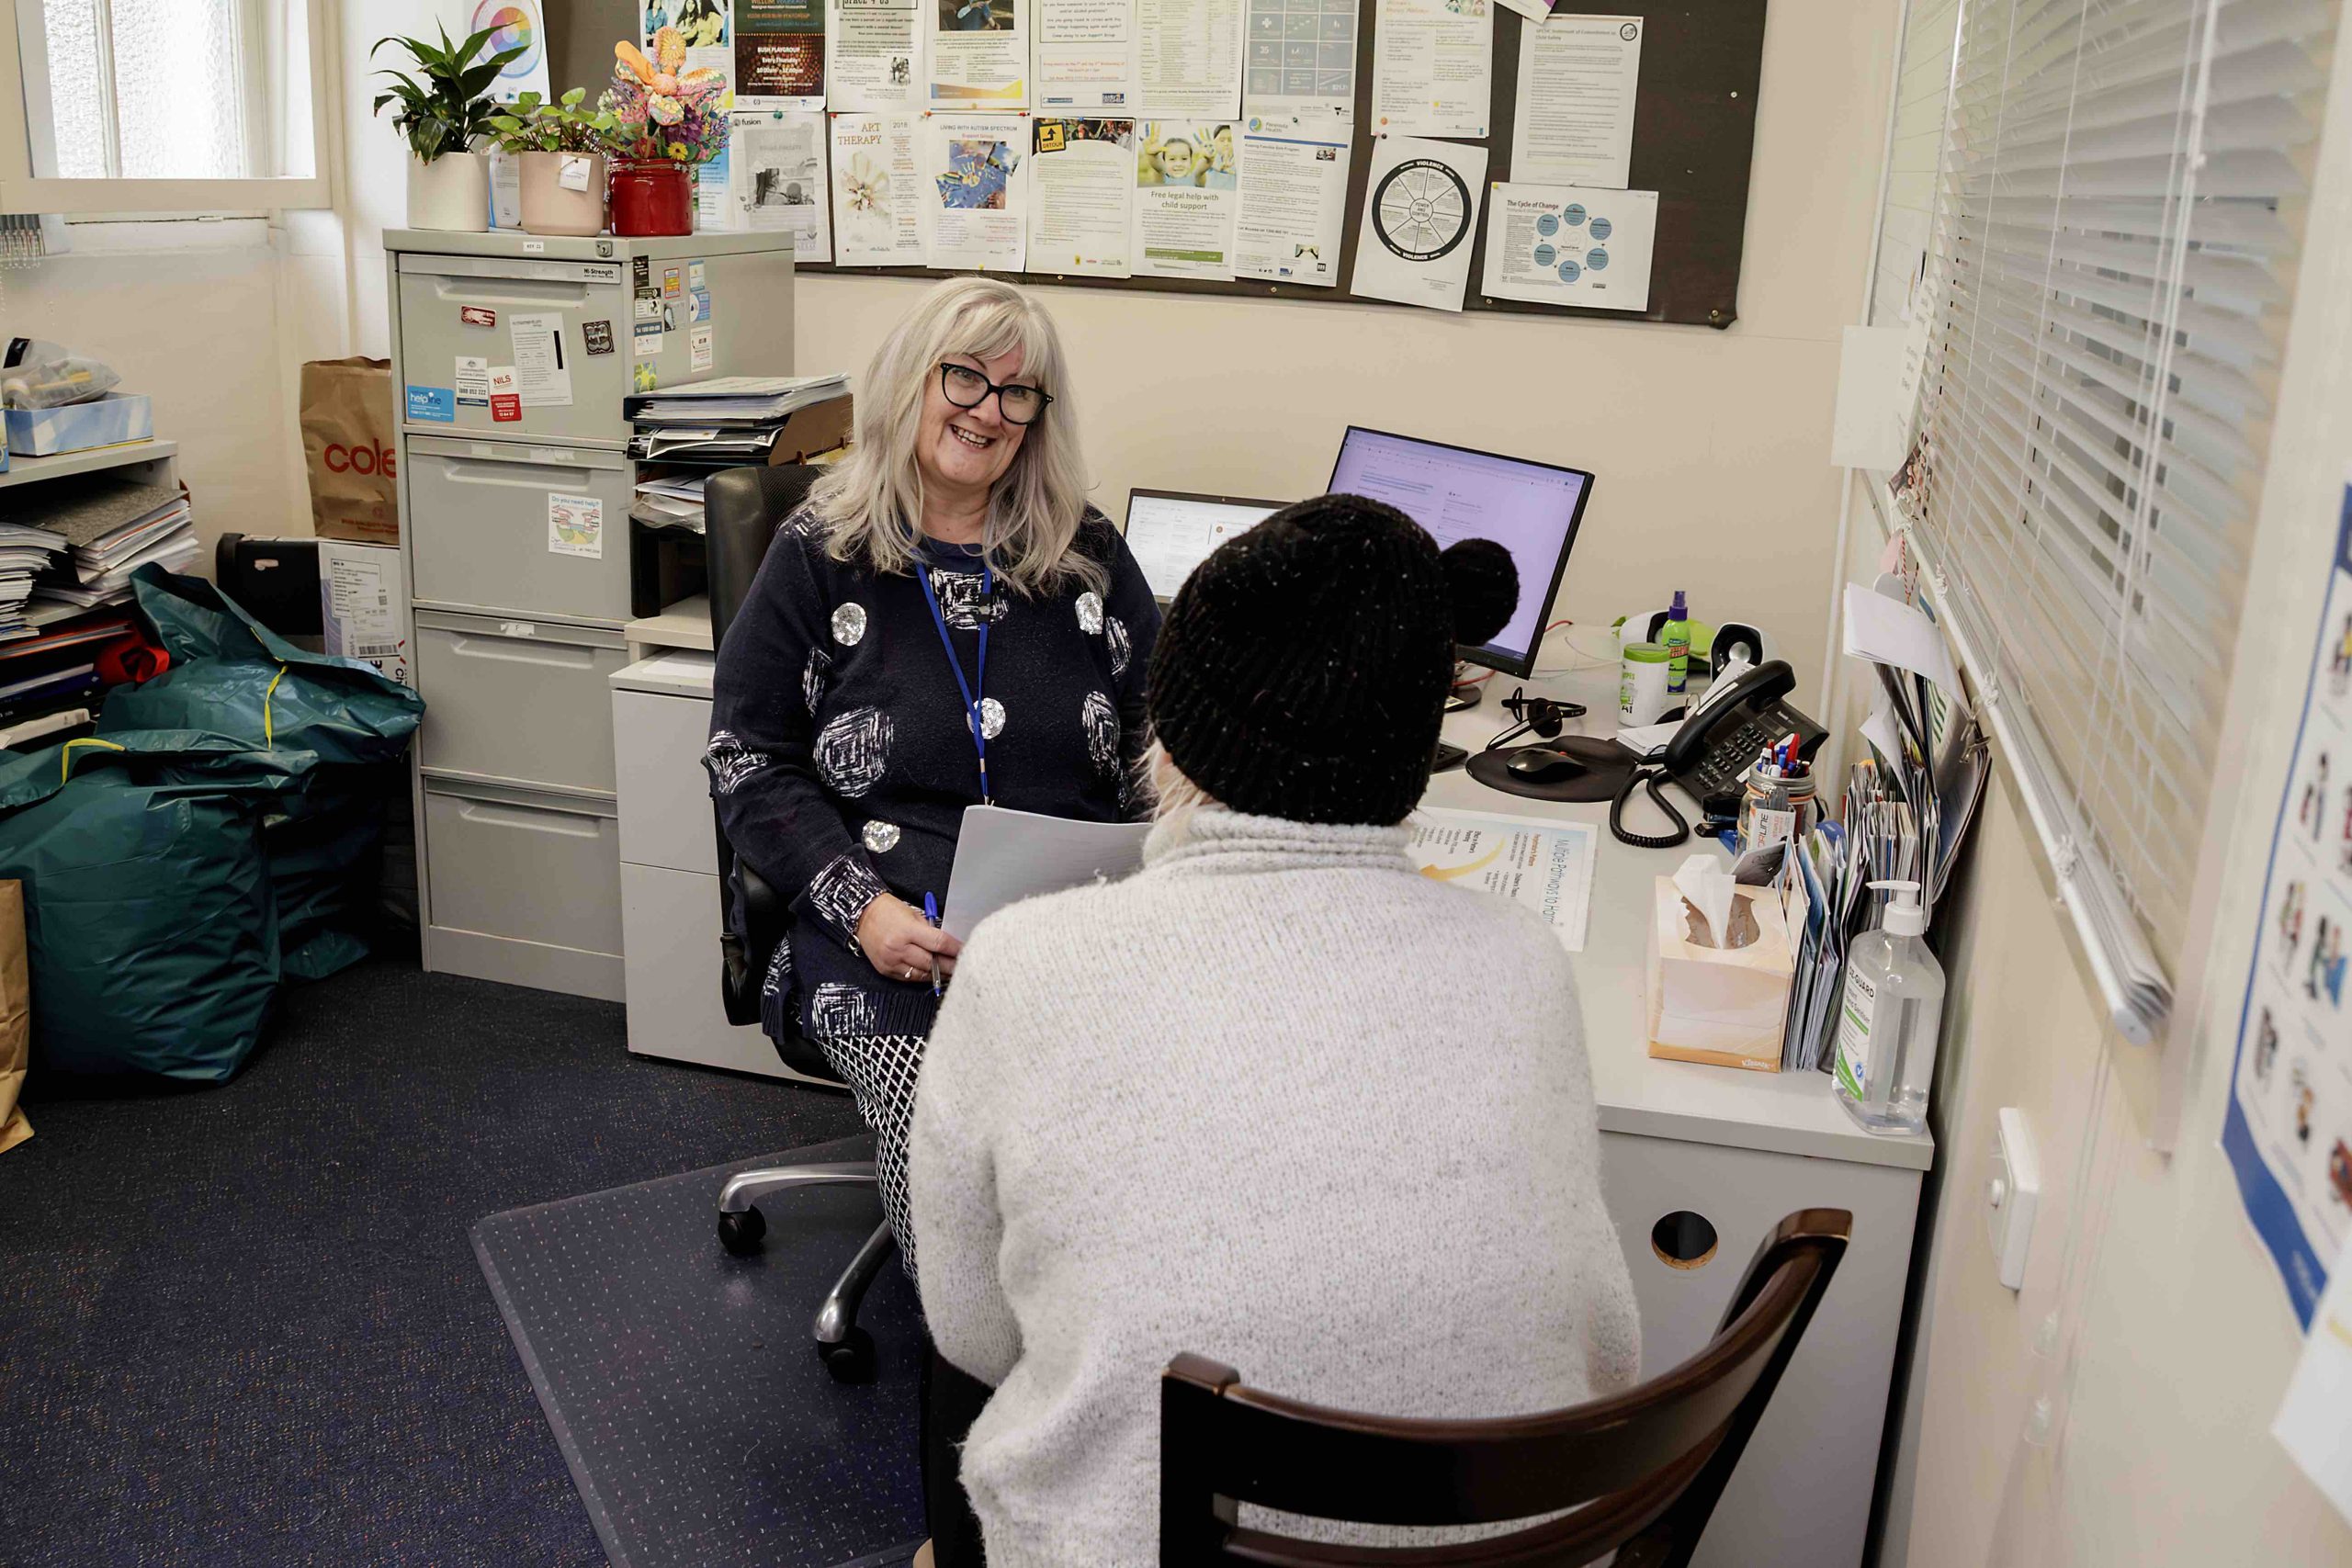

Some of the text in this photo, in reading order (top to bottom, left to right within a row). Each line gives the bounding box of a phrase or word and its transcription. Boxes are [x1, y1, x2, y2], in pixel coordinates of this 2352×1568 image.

[861, 123, 881, 131] ART
[838, 136, 882, 145] THERAPY
[1417, 161, 1444, 171] VIOLENCE
[1168, 192, 1184, 200] legal
[1180, 202, 1207, 210] support
[1518, 200, 1531, 209] Cycle
[493, 375, 511, 385] NILS
[411, 391, 441, 404] helpline
[324, 437, 396, 479] cole
[1553, 838, 1569, 863] Multiple
[1545, 863, 1566, 895] Pathways
